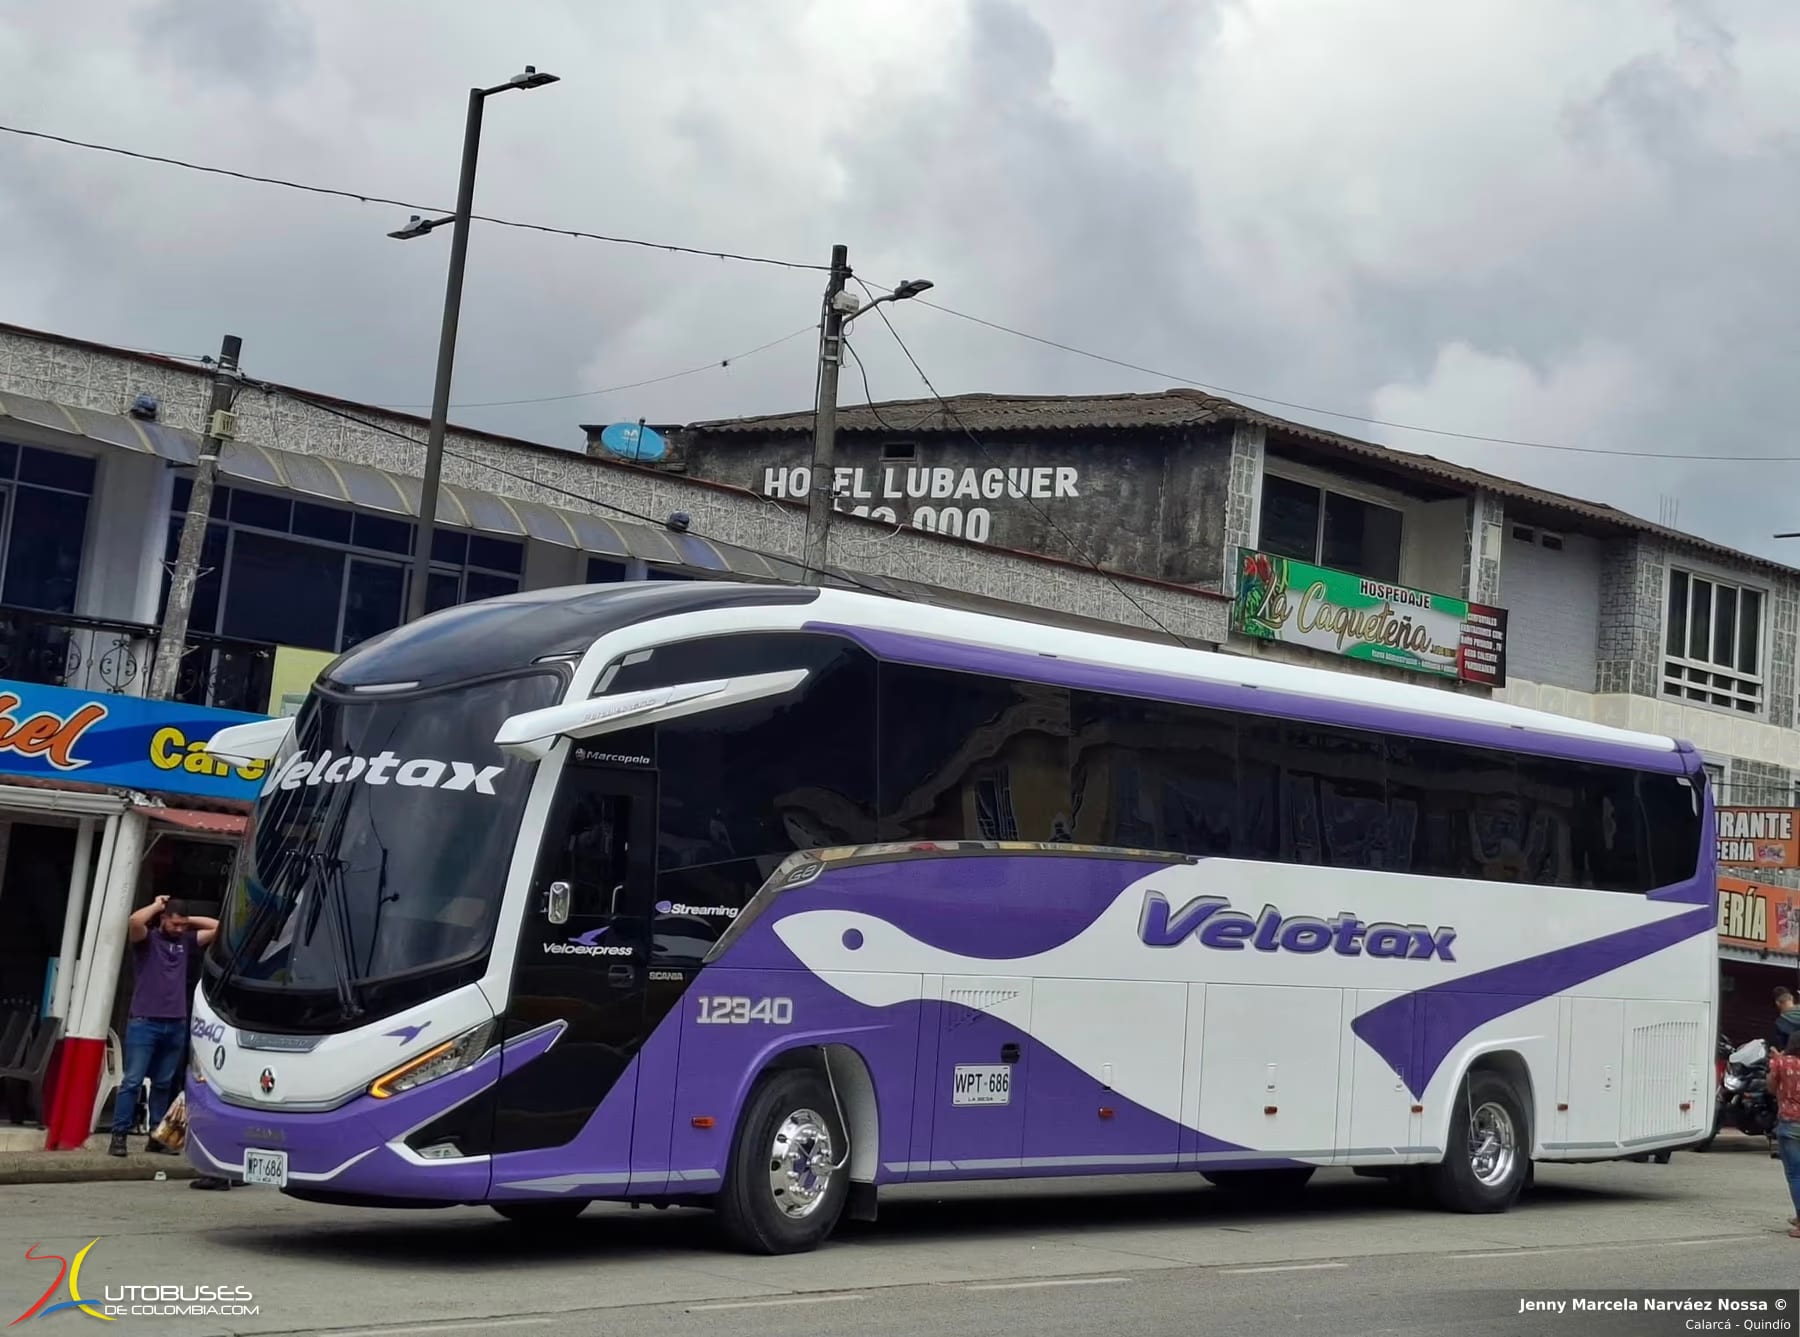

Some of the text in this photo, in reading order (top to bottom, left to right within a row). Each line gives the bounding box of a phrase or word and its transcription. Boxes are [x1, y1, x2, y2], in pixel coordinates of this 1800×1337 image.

[764, 467, 1079, 499] HOEL LUBAGUER
[1360, 579, 1431, 609] HOSPEDAJE
[1252, 572, 1432, 650] La Caqueteña
[586, 750, 650, 765] Marcopolo
[260, 750, 504, 796] Velotax
[1715, 811, 1792, 839] RANTE
[1716, 838, 1755, 862] ERÍA
[671, 903, 738, 918] Streaming
[1137, 889, 1456, 962] Velotax
[543, 942, 633, 957] Veloexpress
[649, 971, 683, 981] SCANIA
[696, 996, 792, 1024] 12340
